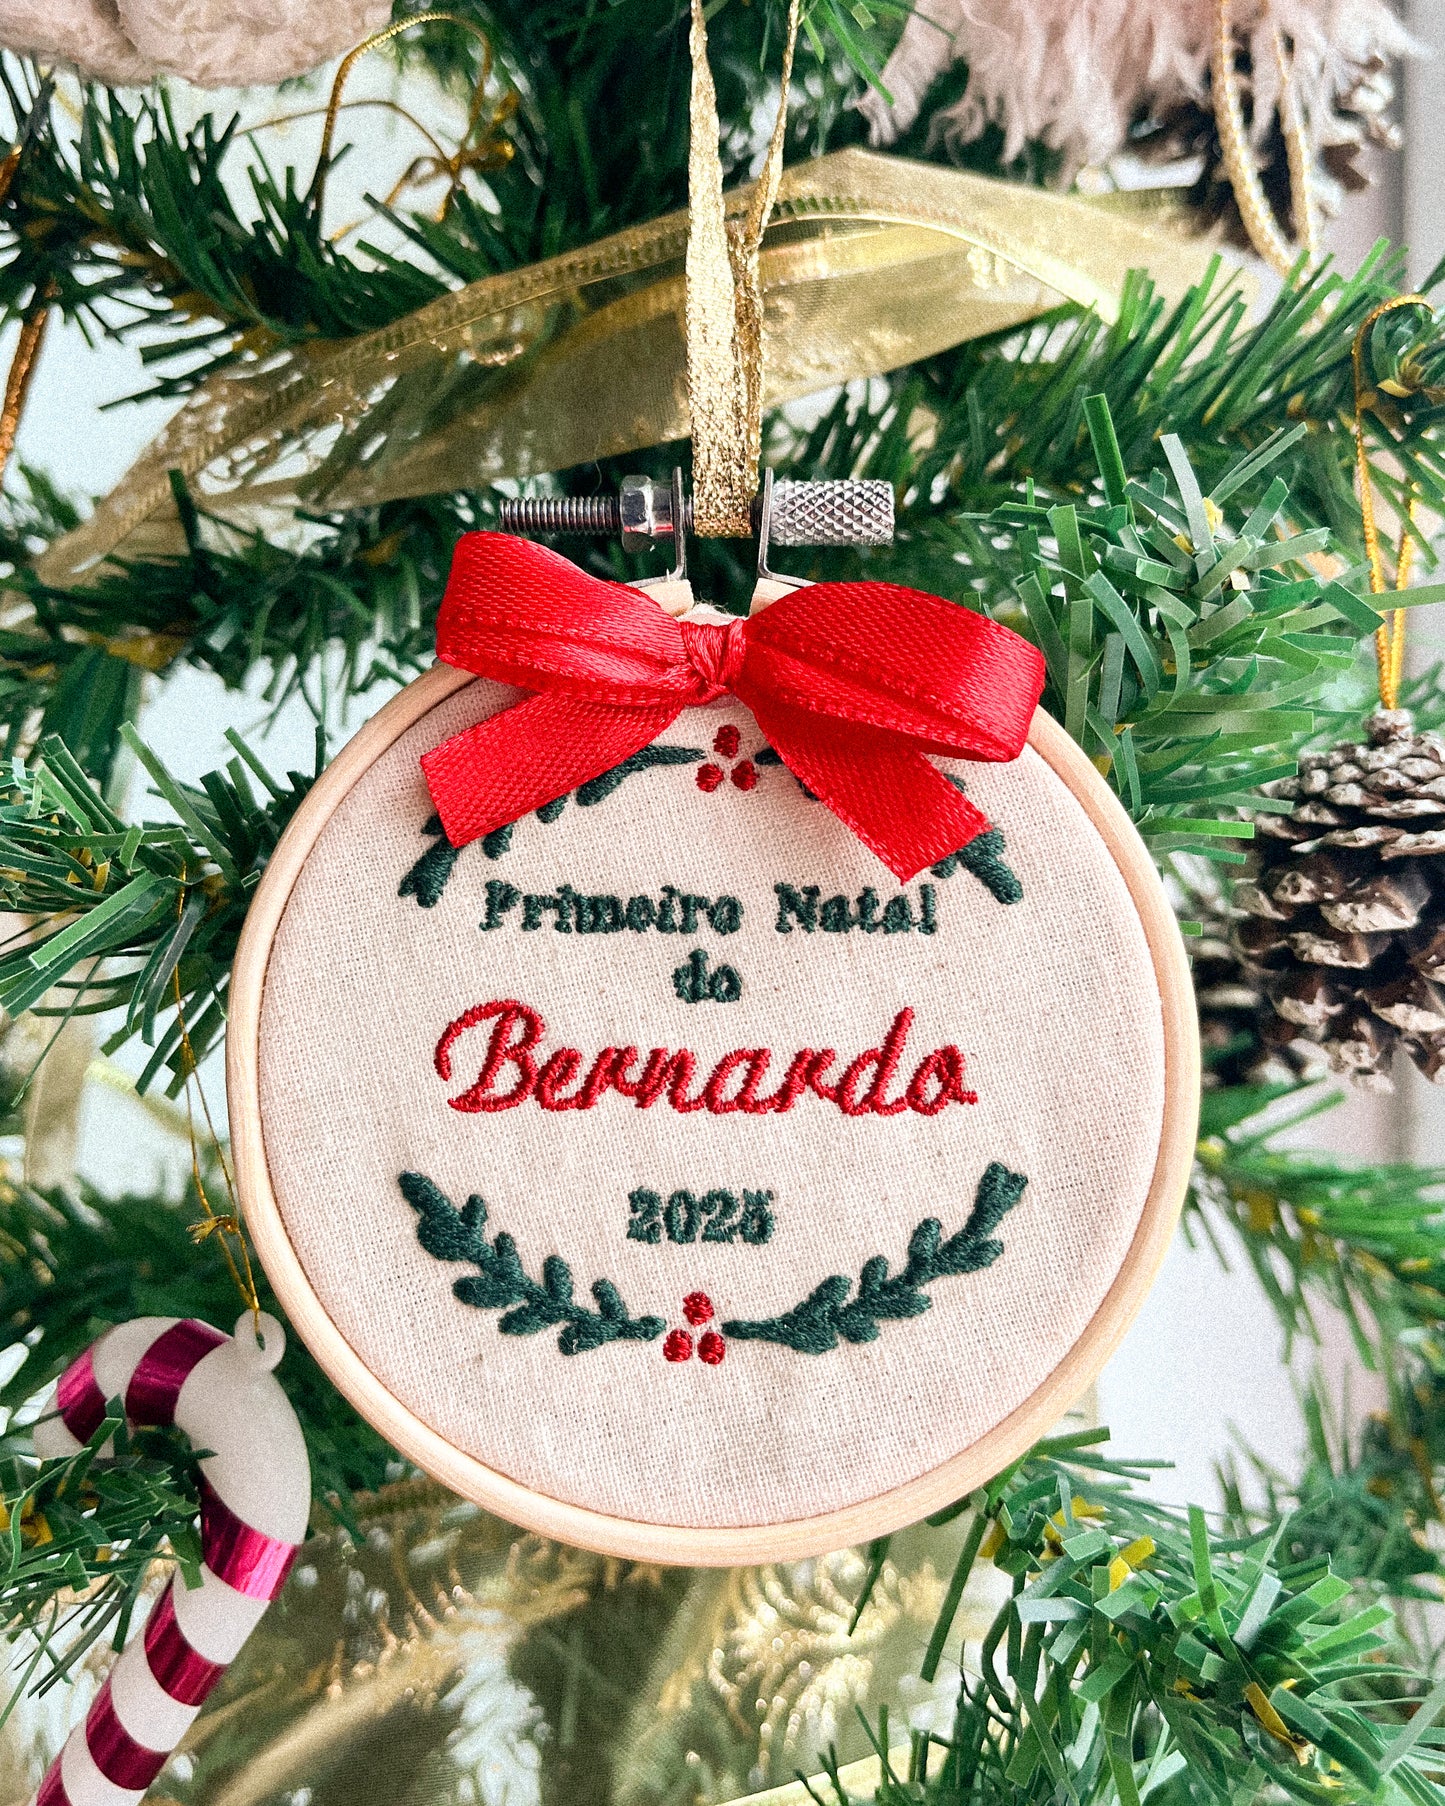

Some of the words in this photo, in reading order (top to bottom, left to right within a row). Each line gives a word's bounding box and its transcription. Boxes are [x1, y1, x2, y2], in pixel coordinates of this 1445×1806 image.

[480, 879, 743, 935] Primeiro
[774, 881, 938, 936] Natal
[672, 948, 743, 1004] do
[433, 998, 979, 1116] Bernardo
[626, 1186, 775, 1245] 2025
